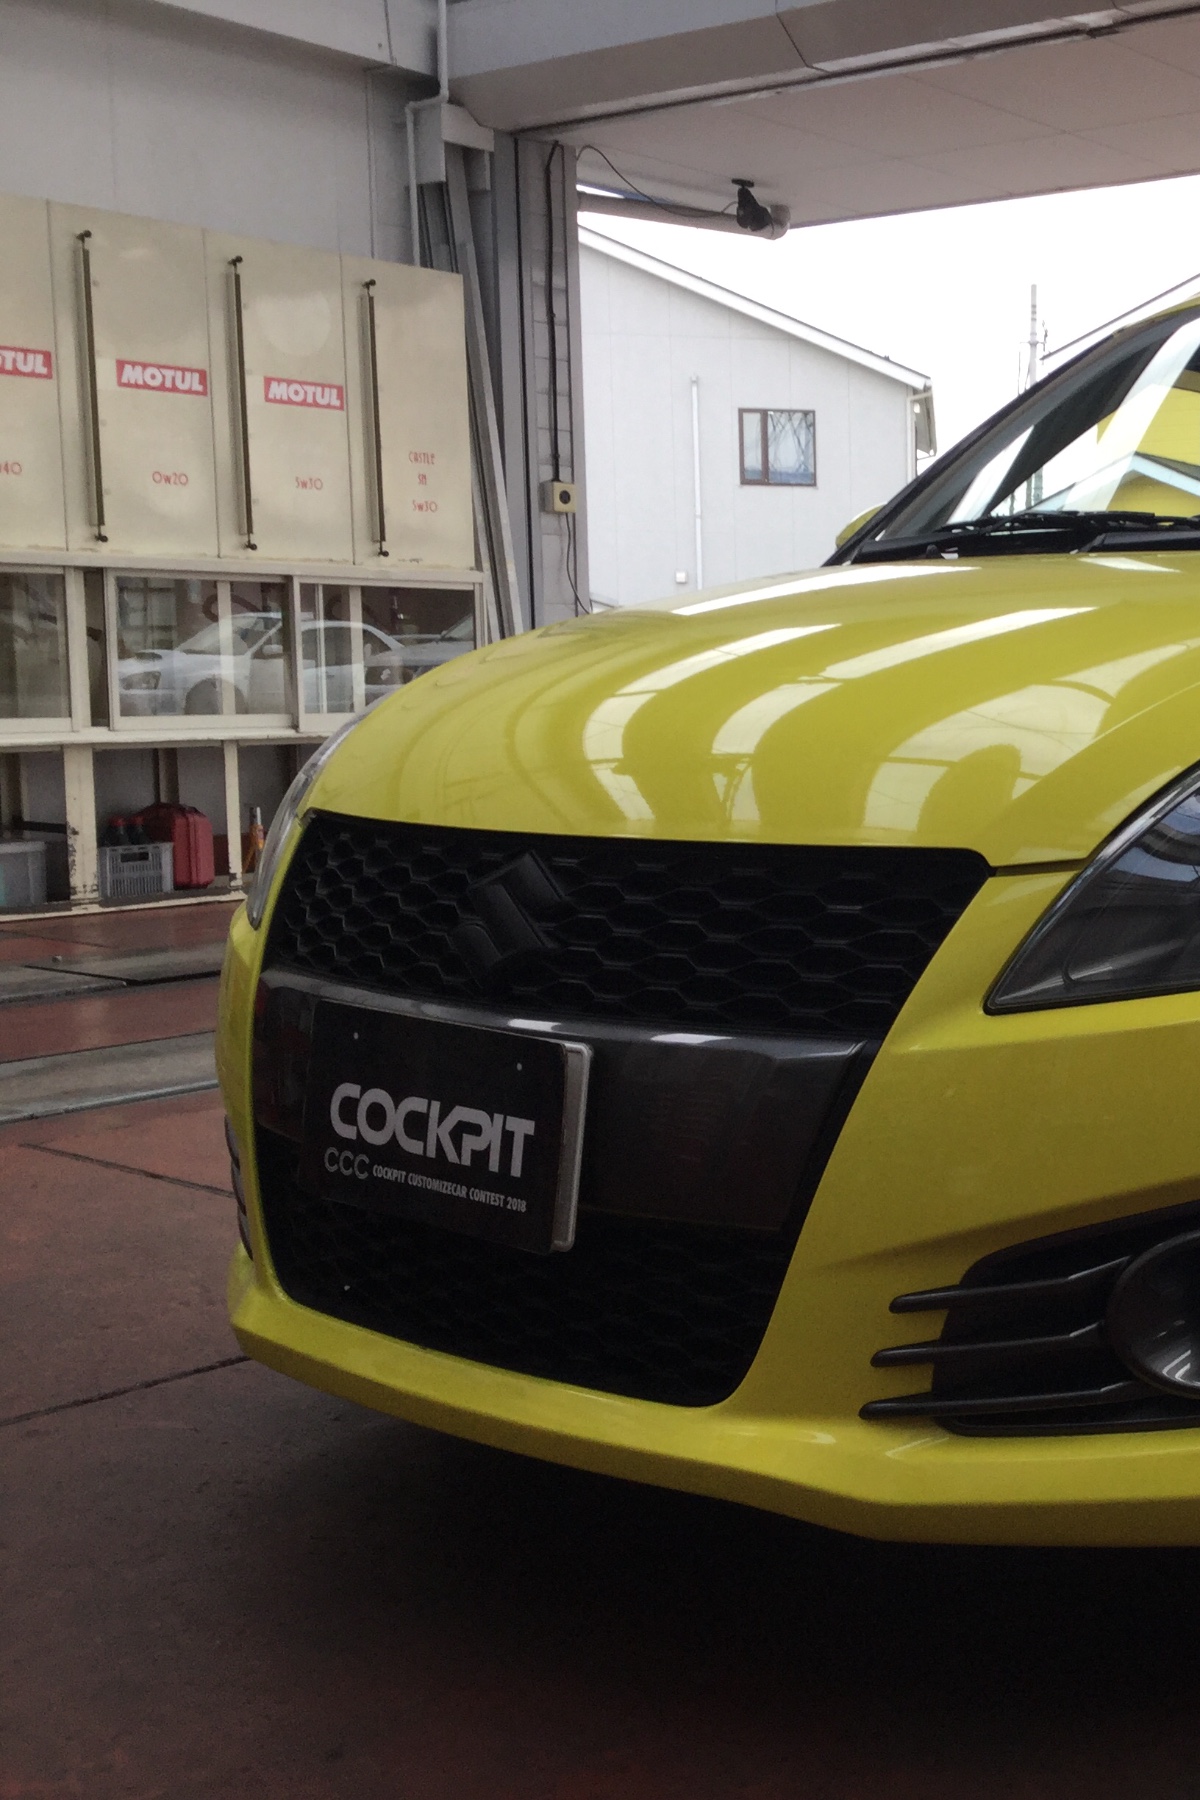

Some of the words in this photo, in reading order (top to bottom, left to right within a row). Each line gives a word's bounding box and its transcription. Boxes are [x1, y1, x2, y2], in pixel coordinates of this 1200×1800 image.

[121, 363, 203, 392] MOTUL
[268, 380, 341, 407] MOTUL
[330, 1082, 535, 1178] COCKPIT
[324, 1146, 370, 1180] CCC
[372, 1164, 406, 1184] COCKPIT
[407, 1172, 468, 1199] CUSTOMIZECAR
[469, 1187, 506, 1208] CONTEST
[507, 1196, 527, 1213] 2018
